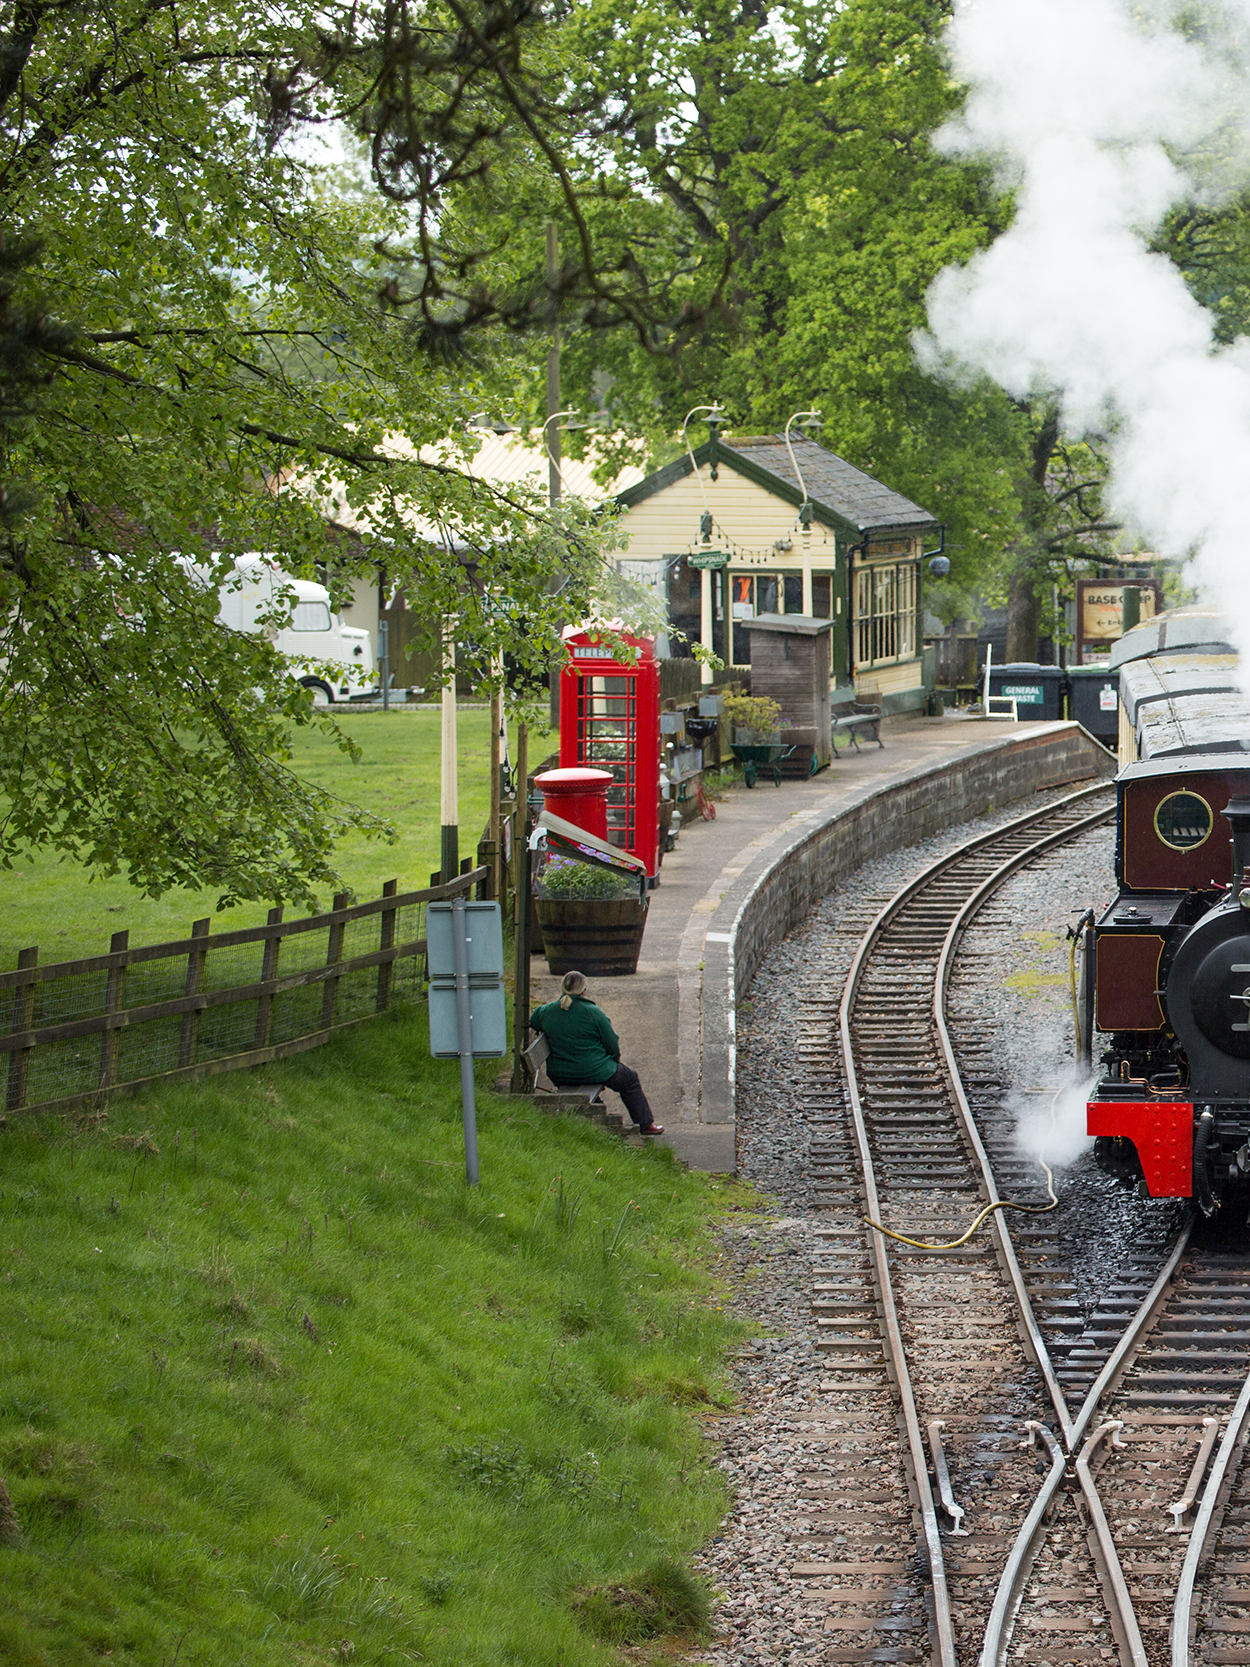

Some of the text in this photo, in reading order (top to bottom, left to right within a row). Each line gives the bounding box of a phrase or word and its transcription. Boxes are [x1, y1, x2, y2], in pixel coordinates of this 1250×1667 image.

[693, 554, 728, 566] WHIPSNADE
[1088, 595, 1117, 604] BASE
[1005, 686, 1040, 695] GENERAL
